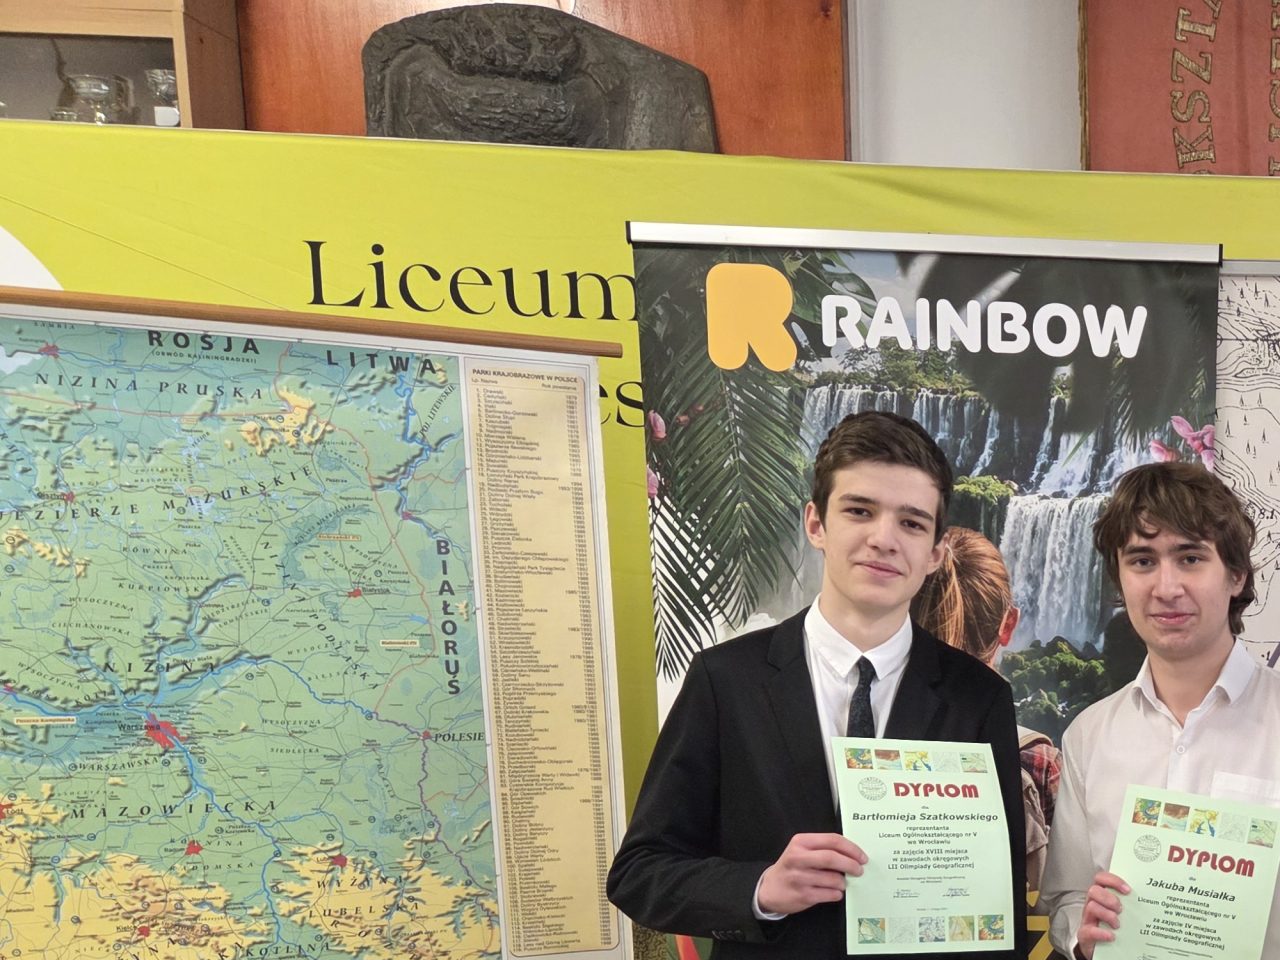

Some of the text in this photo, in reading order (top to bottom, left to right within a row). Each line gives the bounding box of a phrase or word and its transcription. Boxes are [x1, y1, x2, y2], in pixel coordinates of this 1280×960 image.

[303, 240, 638, 322] Liceum
[821, 294, 1147, 359] RAINBOW
[149, 330, 260, 355] ROSJA
[326, 350, 437, 377] LITWA
[35, 373, 262, 399] NIZINA PRUSKA
[436, 539, 461, 695] BIAŁORUŚ
[434, 732, 485, 743] POLESIE
[894, 782, 979, 798] DYPLOM
[70, 799, 277, 820] MAZOWIECKA
[852, 812, 998, 822] Bartłomieja Szatkowskiego
[1167, 845, 1255, 877] DYPLOM
[1146, 878, 1236, 902] Jakuba Musiałka
